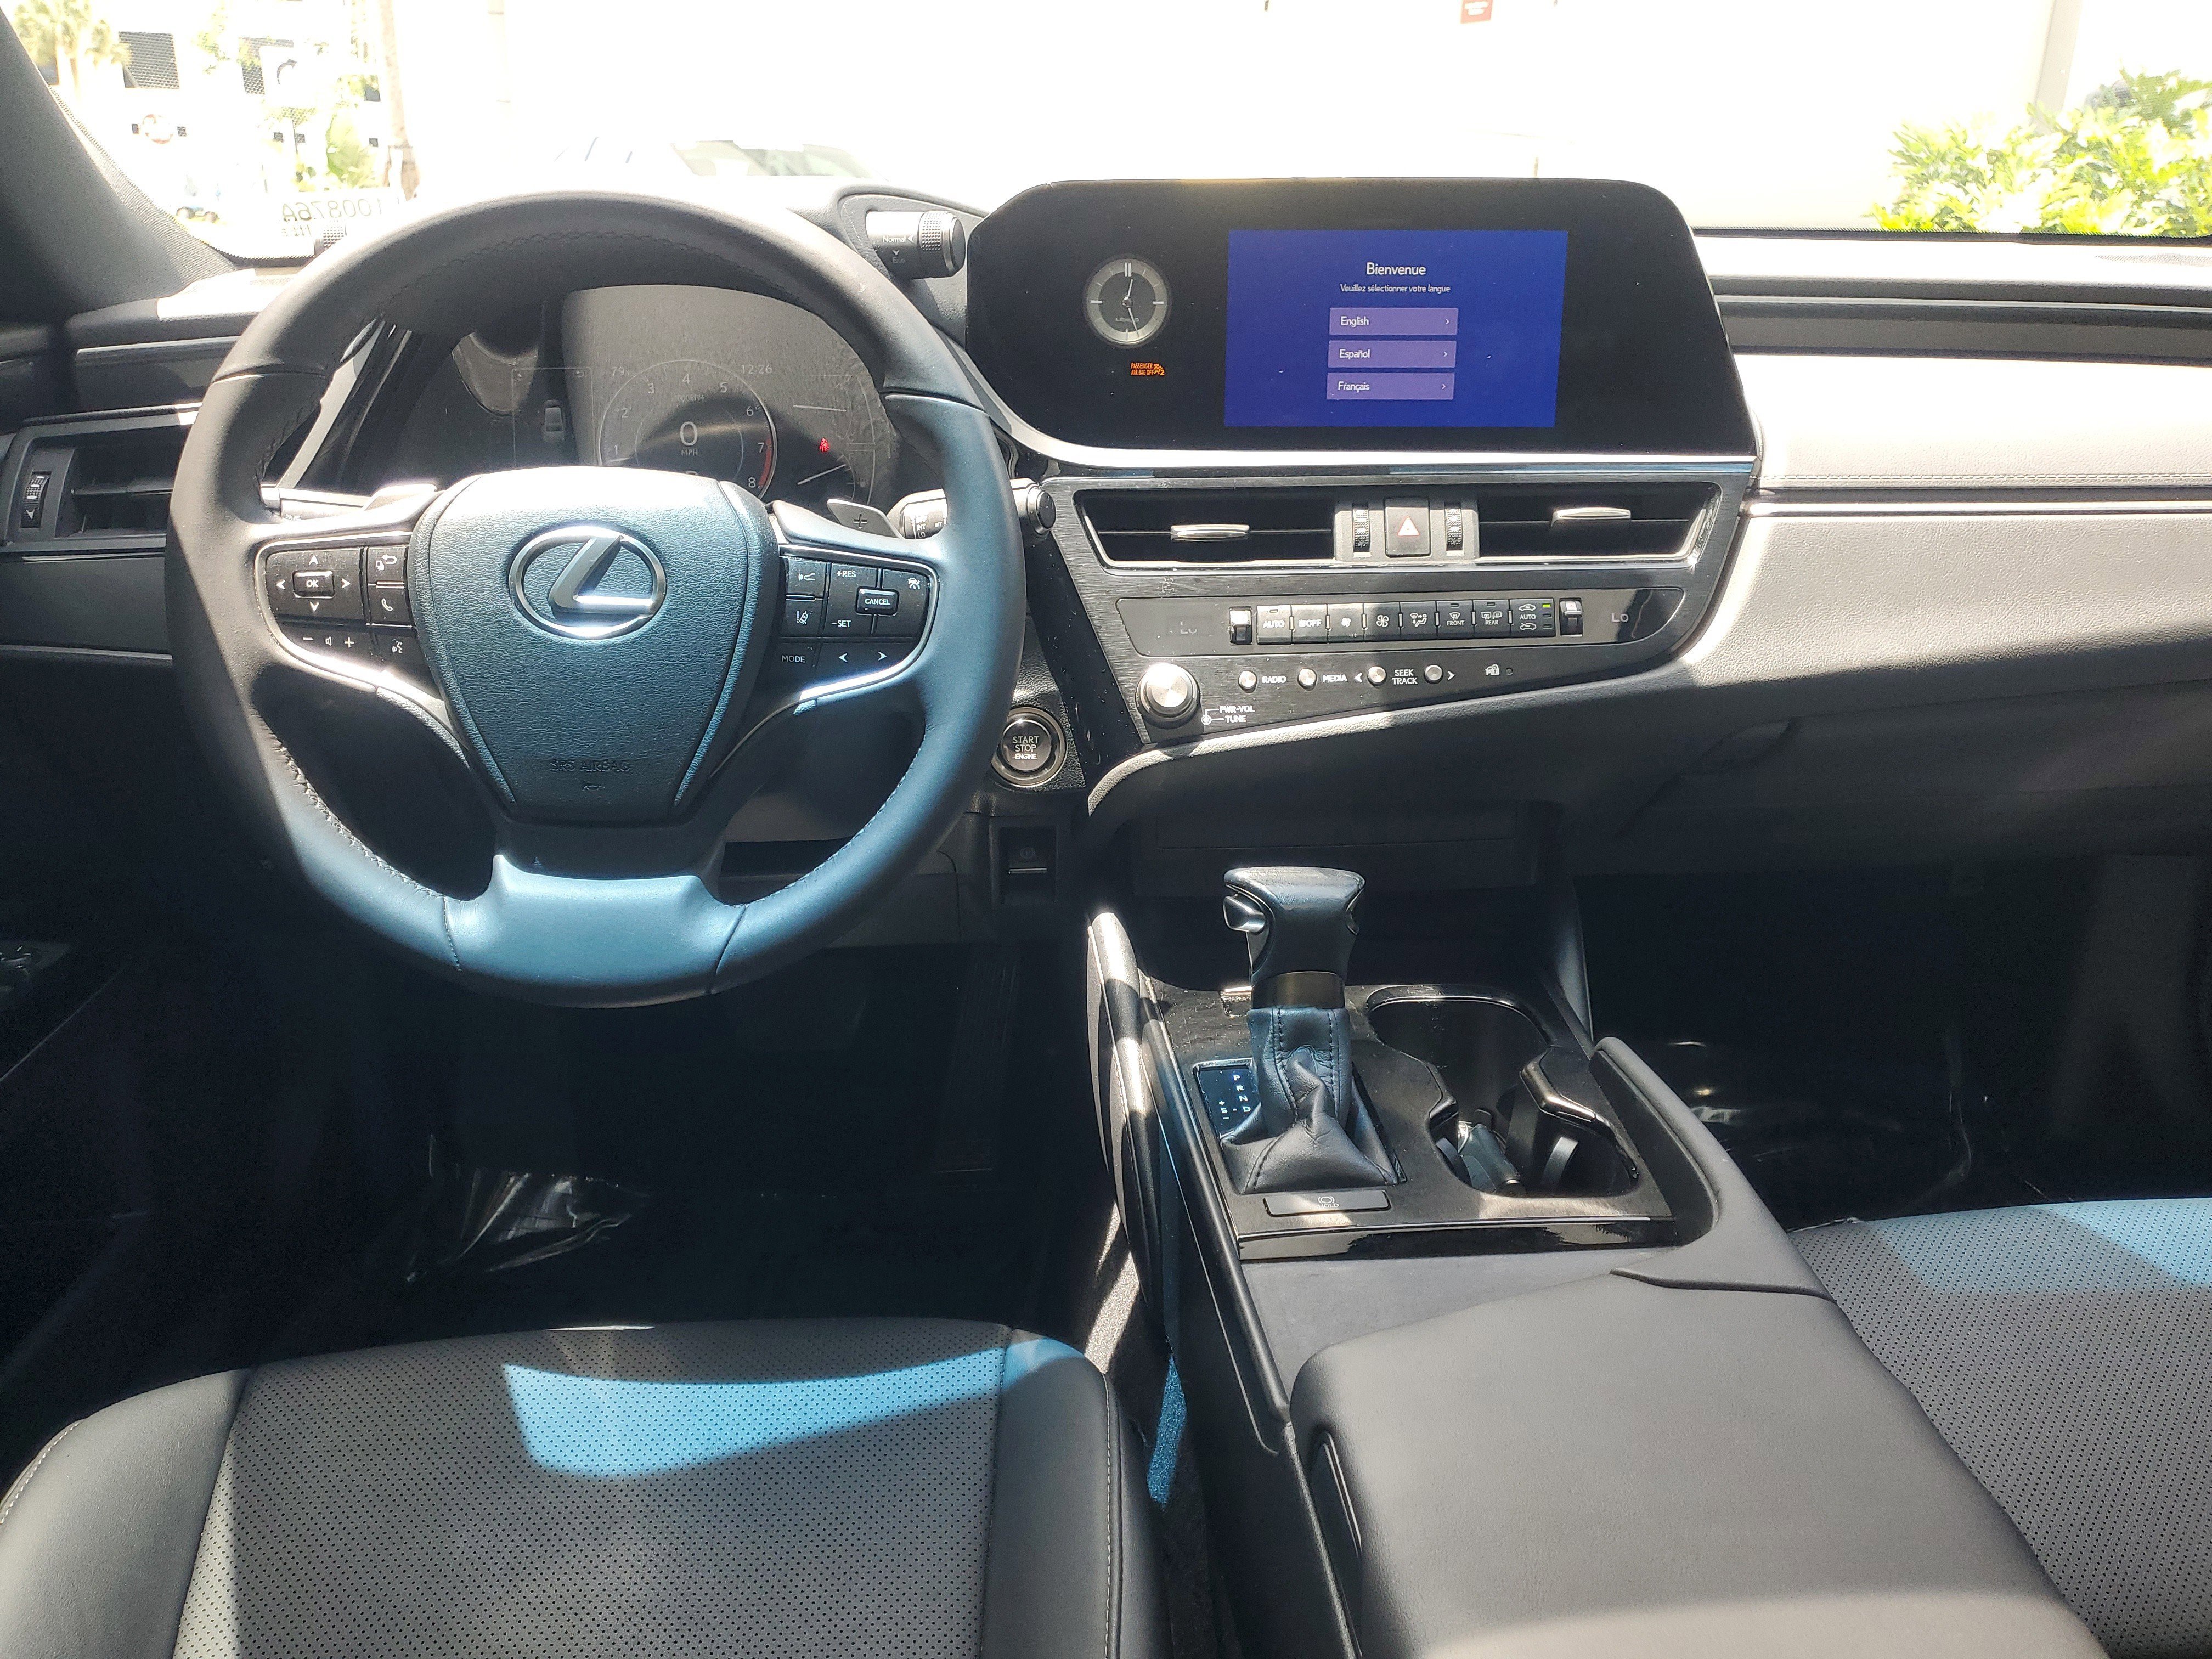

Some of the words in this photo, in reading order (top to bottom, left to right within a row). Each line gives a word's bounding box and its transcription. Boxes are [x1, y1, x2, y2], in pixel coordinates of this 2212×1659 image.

[882, 235, 906, 243] Normal
[1366, 262, 1426, 275] Bienvenue
[1340, 284, 1366, 292] Veuillez
[1367, 284, 1407, 292] sélectionner
[1427, 284, 1451, 294] langue
[1340, 316, 1369, 327] English
[1339, 349, 1370, 359] Español
[682, 373, 691, 384] 4
[647, 383, 654, 394] 3
[720, 382, 727, 393] 5
[1338, 381, 1370, 392] Français
[621, 408, 629, 419] 2
[746, 406, 754, 416] 6
[680, 421, 698, 446] 0
[614, 444, 618, 455] 1
[758, 442, 765, 454] 7
[748, 477, 756, 488] 8
[306, 579, 319, 588] OK
[1611, 612, 1629, 623] Lo
[1263, 620, 1285, 628] AUTO
[781, 654, 806, 663] MODE
[1322, 674, 1347, 682] MEDIA
[1394, 669, 1414, 677] SEEK
[1262, 675, 1287, 684] RADIO
[1391, 677, 1418, 685] TRACK
[1224, 714, 1246, 723] TUNE
[1012, 736, 1040, 744] START
[1015, 744, 1036, 752] STOP
